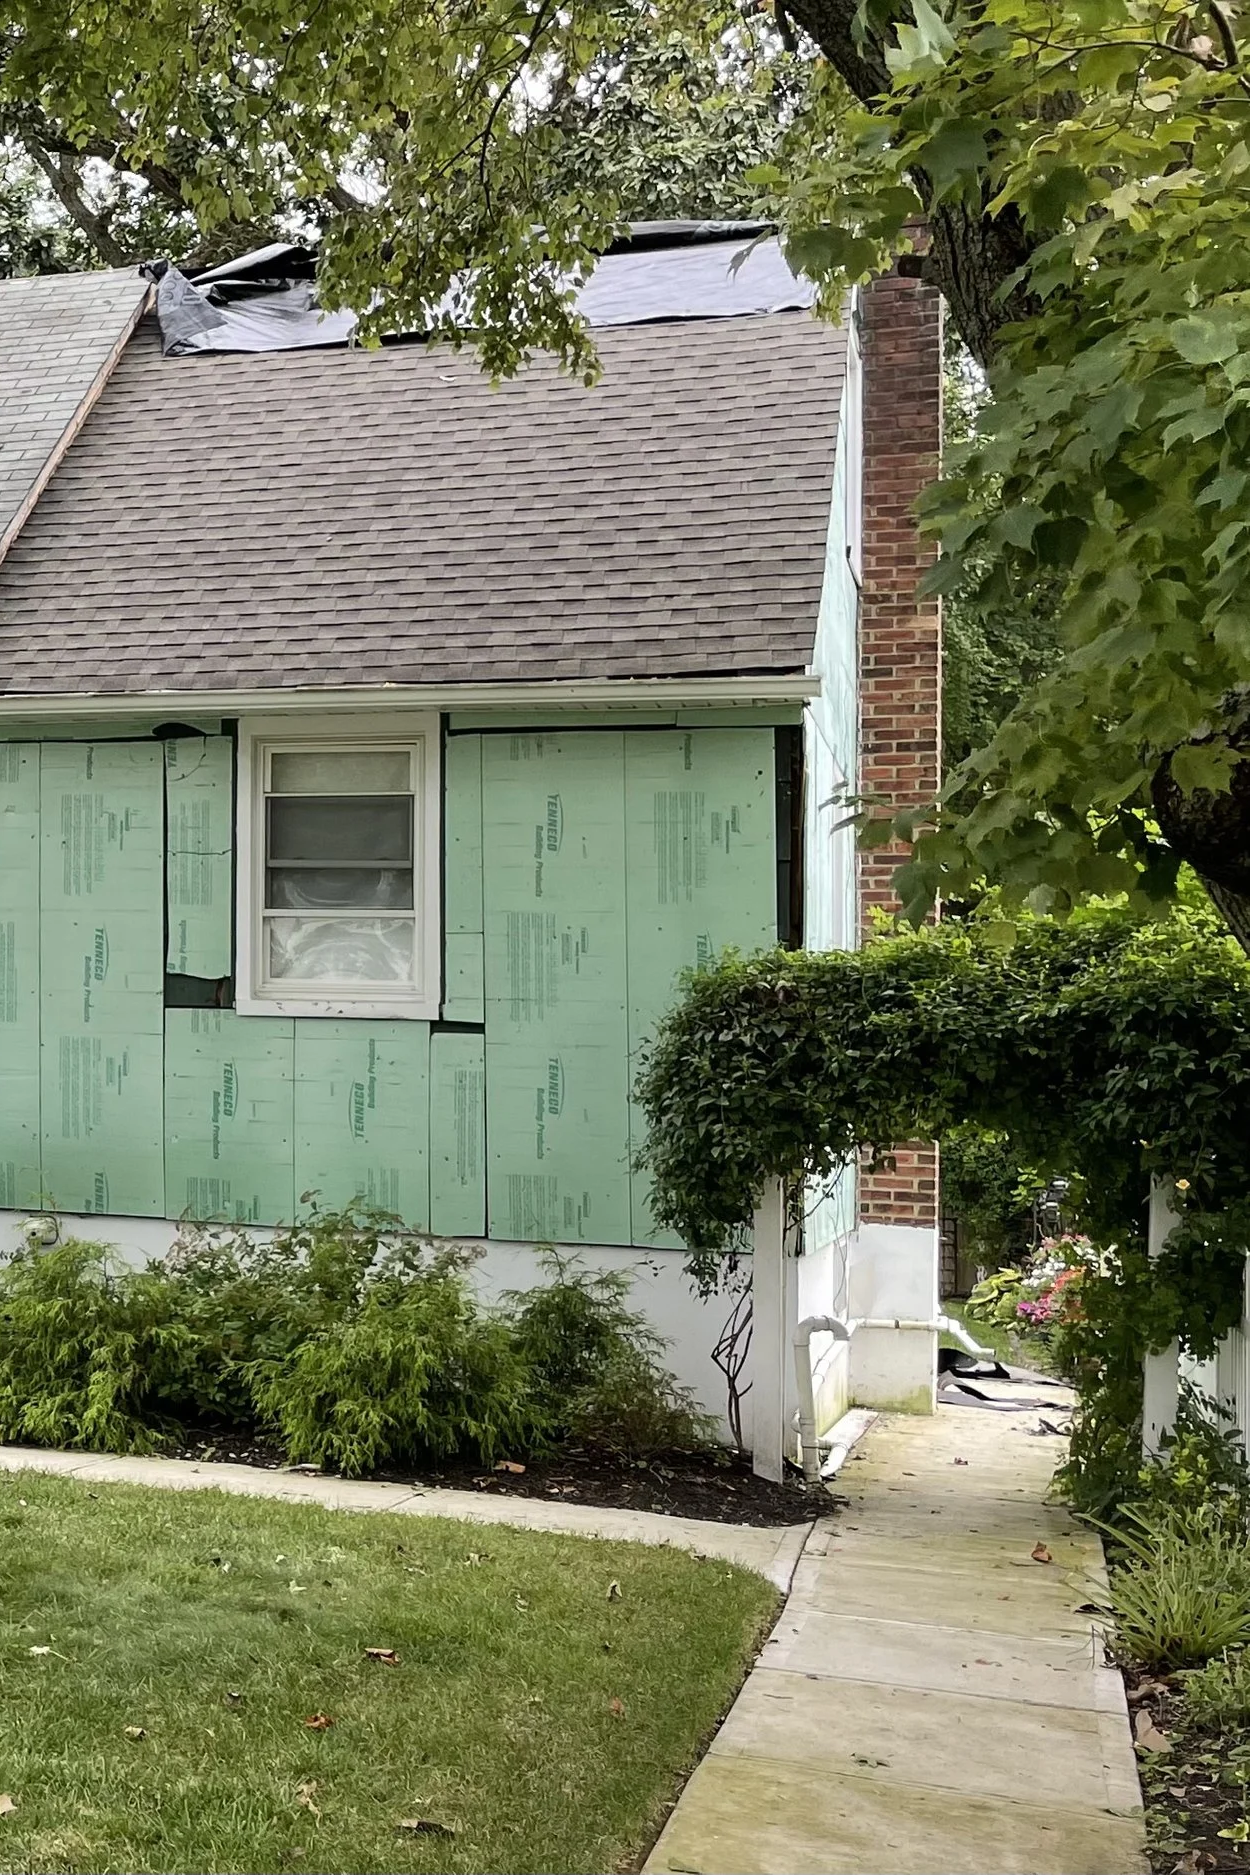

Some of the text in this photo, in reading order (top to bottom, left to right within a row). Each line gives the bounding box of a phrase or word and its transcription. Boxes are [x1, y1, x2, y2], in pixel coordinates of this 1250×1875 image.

[547, 794, 558, 852] TENNECO
[94, 928, 104, 981] TENNECO
[223, 1063, 233, 1117] TENNECO
[354, 1083, 364, 1138] TENNECO
[548, 1058, 559, 1115] TENNECO
